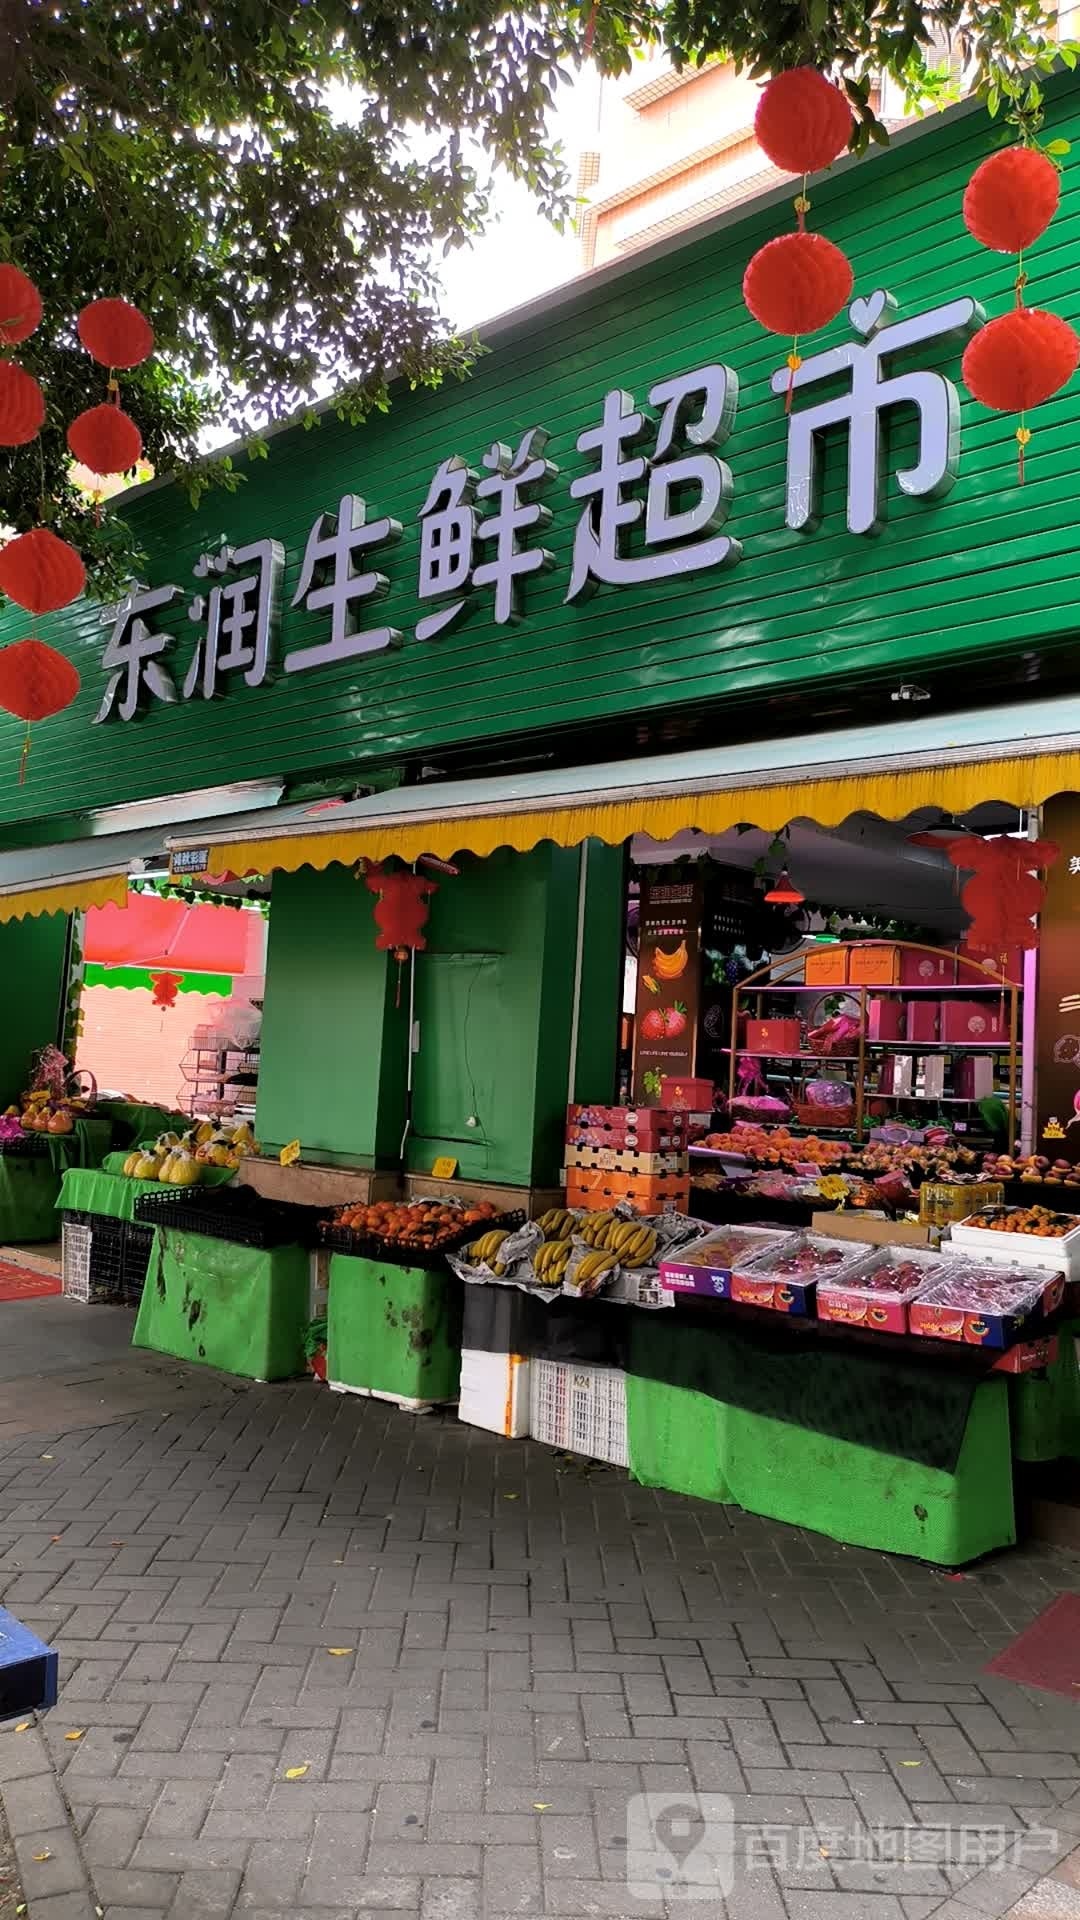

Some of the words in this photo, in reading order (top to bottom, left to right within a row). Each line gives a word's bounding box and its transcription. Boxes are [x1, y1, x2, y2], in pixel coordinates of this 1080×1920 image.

[93, 291, 982, 723] 东润生鲜超市
[574, 1374, 590, 1389] K24
